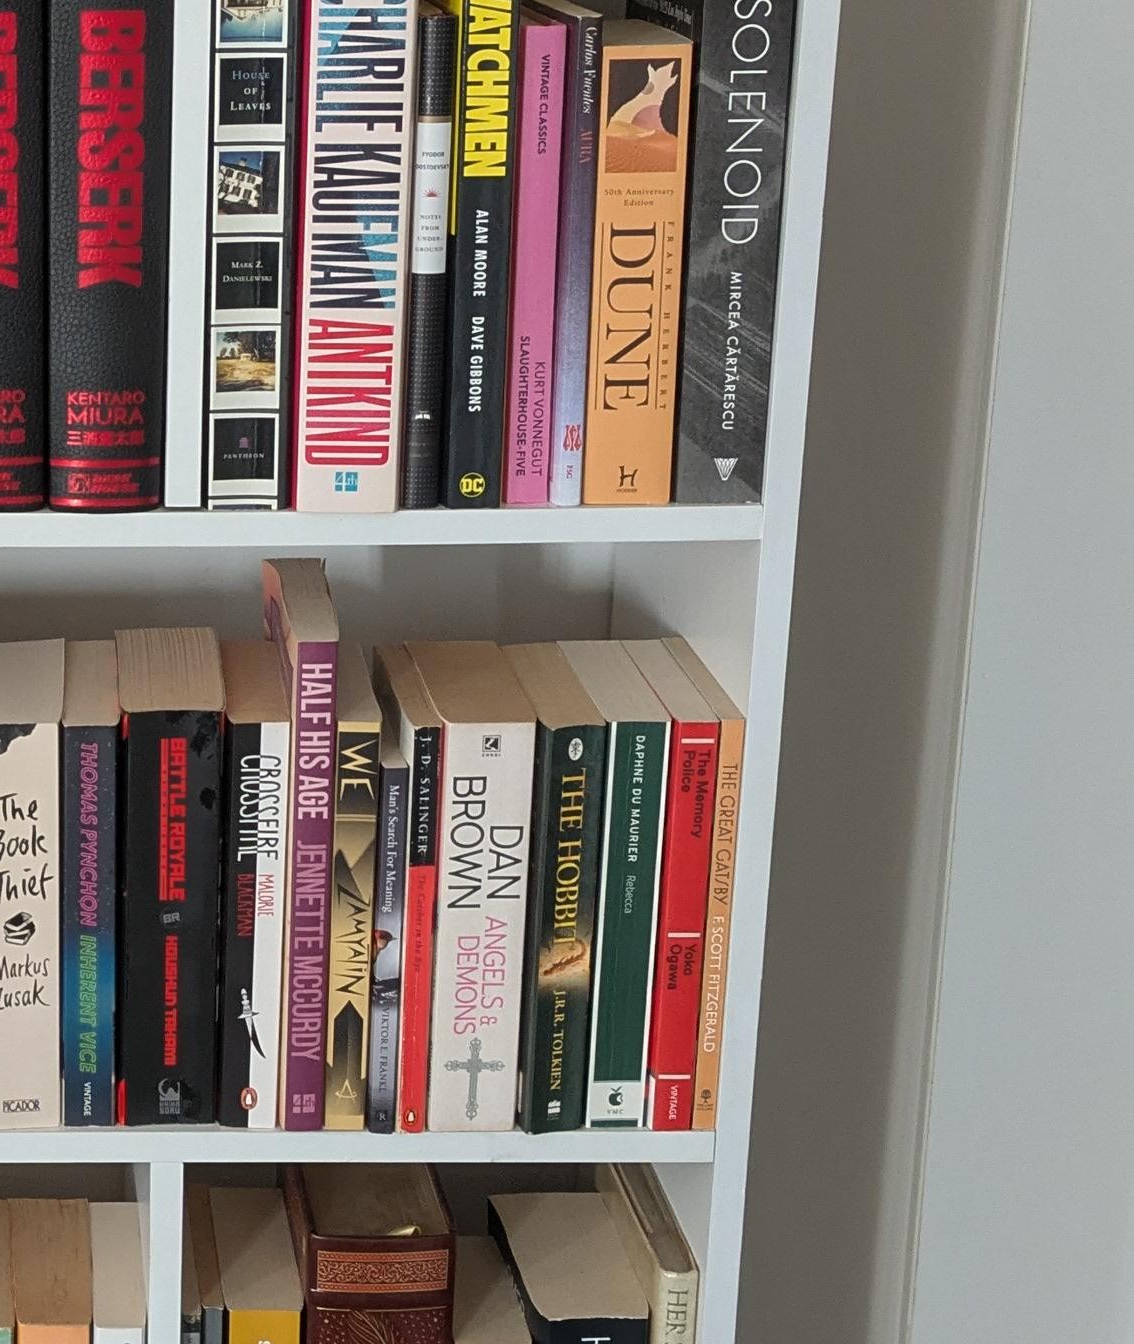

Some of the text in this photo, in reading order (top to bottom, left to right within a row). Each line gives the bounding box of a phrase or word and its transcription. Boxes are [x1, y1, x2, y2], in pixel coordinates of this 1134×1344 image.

[77, 9, 146, 289] BERSERK
[308, 143, 403, 310] KAUFMAN
[605, 222, 655, 411] DUNE
[304, 318, 397, 467] ANTKIND
[468, 357, 484, 413] GIBBONS
[531, 396, 545, 476] VONNEGUT
[299, 662, 333, 725] HALF
[447, 775, 488, 910] BROWN
[691, 773, 709, 838] Memory
[489, 824, 524, 901] DAN
[555, 843, 582, 945] HOBBIT
[624, 875, 636, 914] Rebecca
[703, 974, 721, 1053] FITZGERALD
